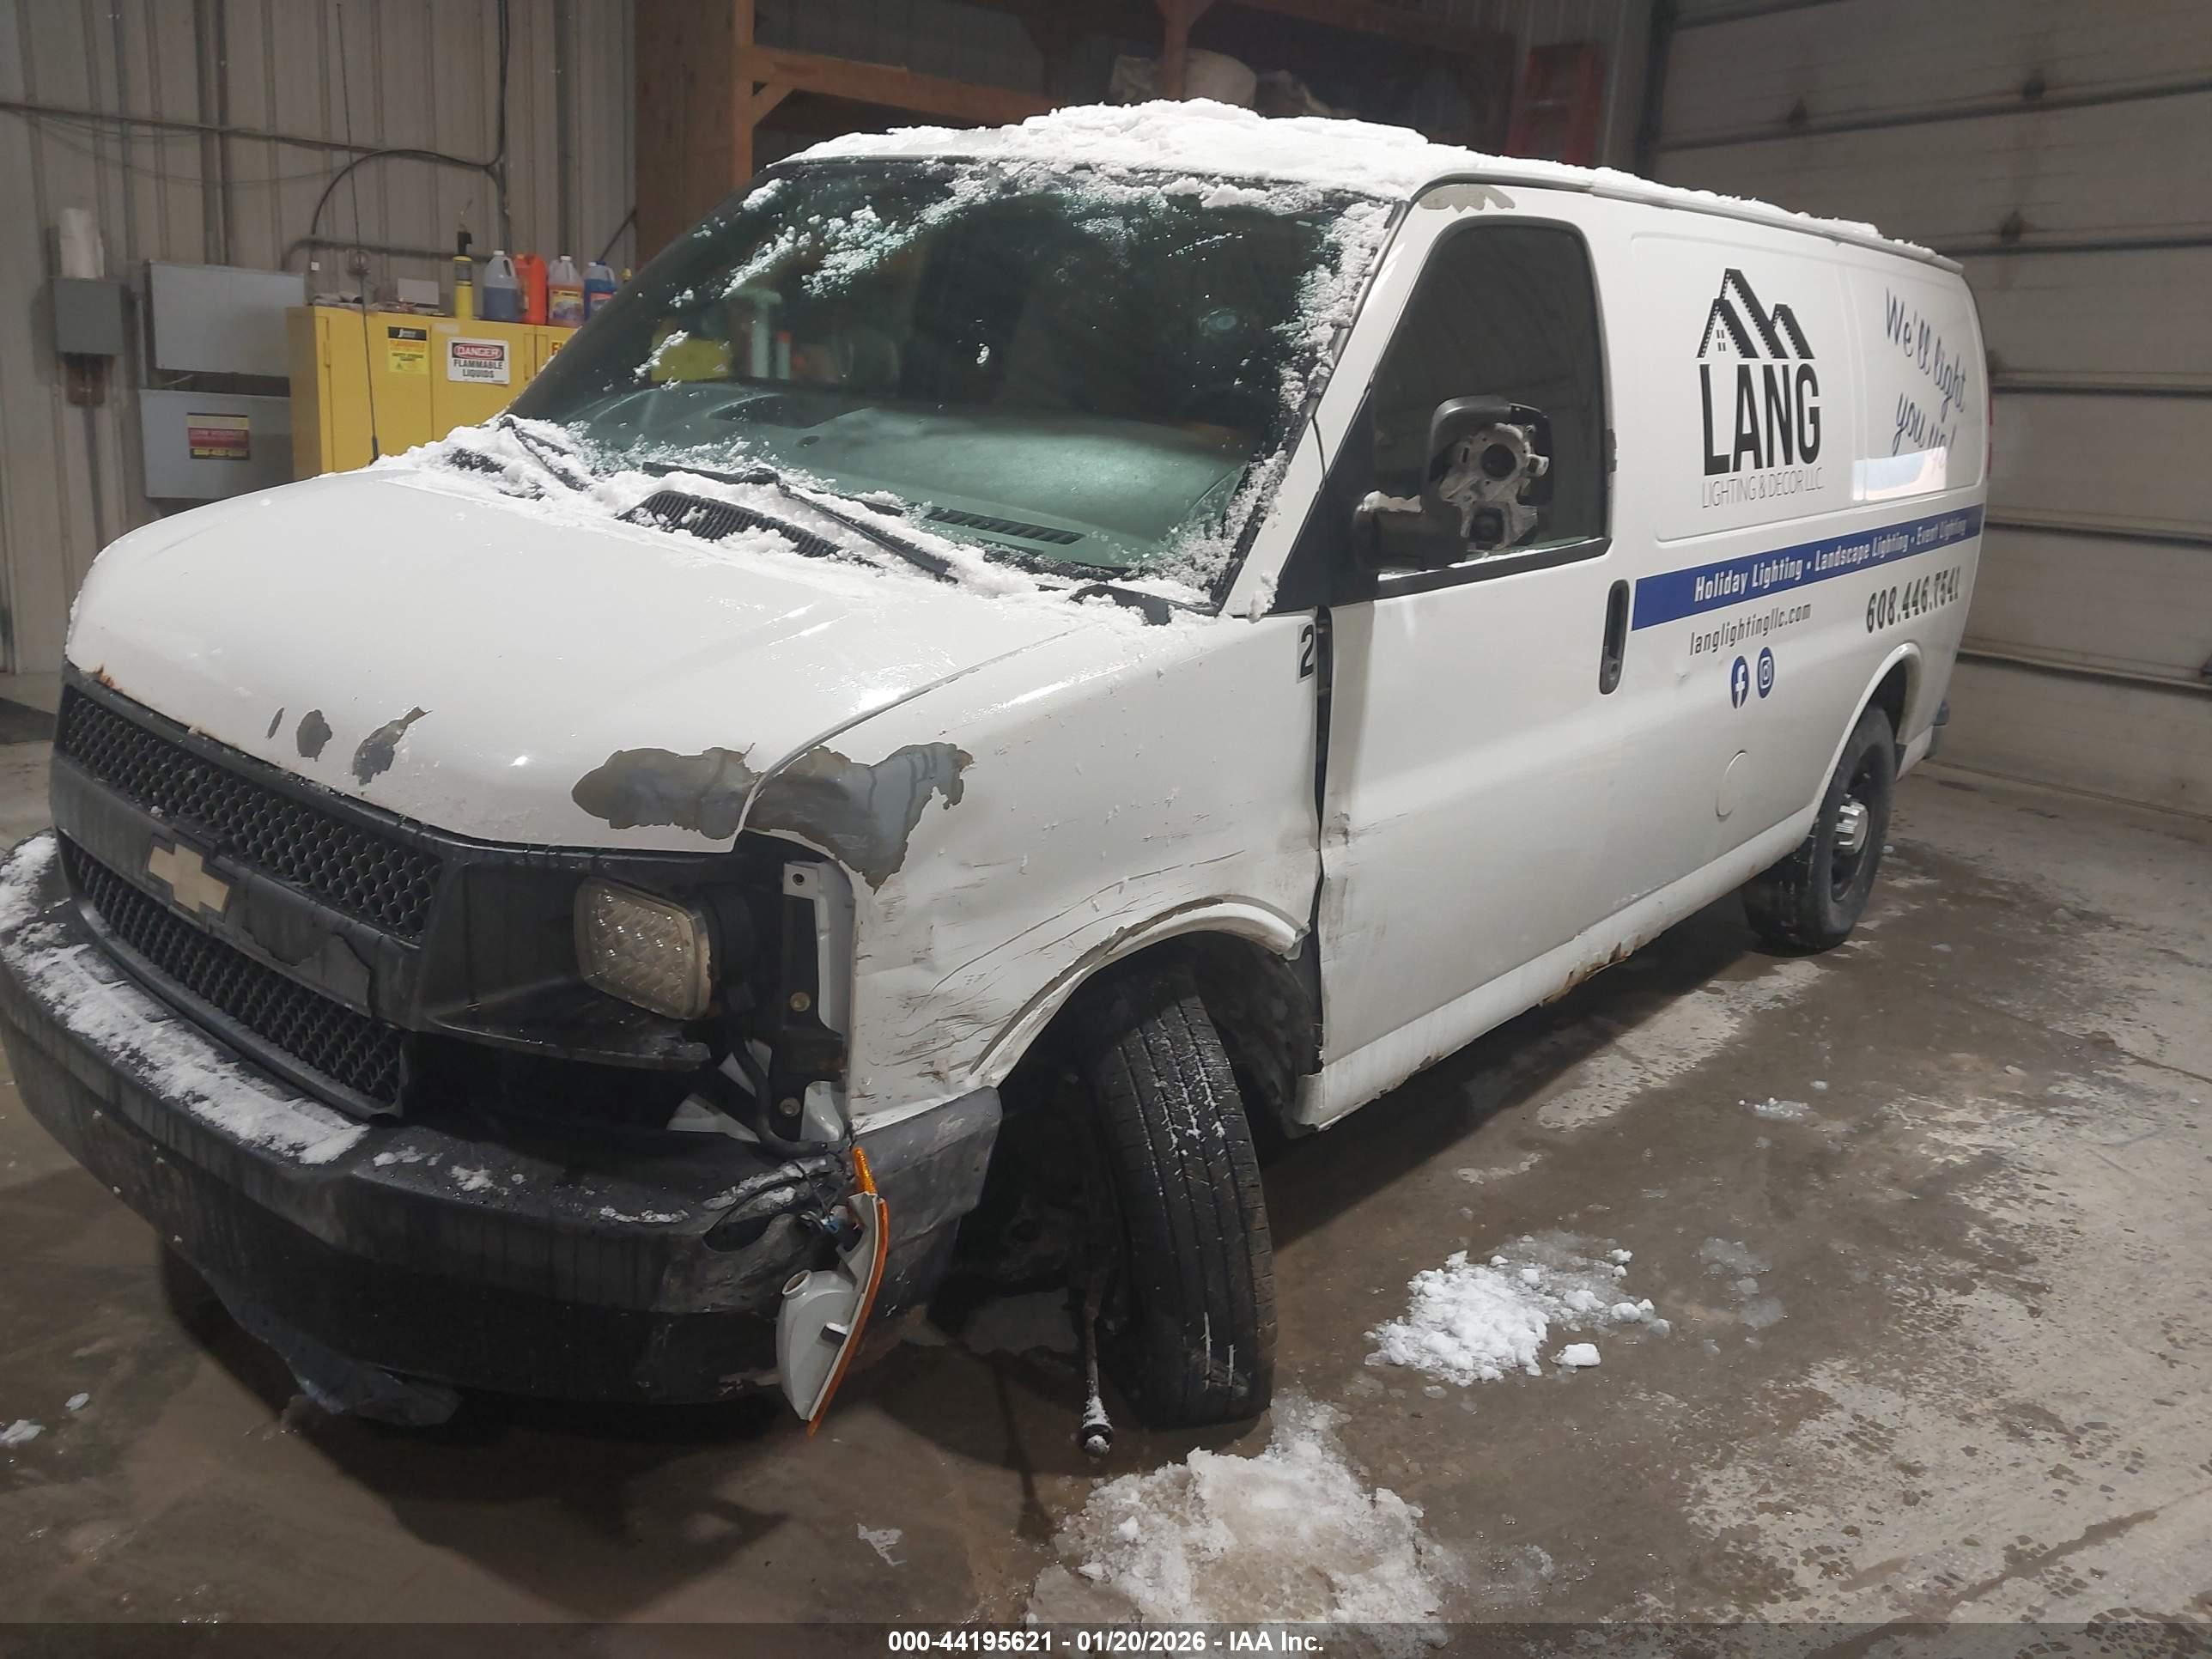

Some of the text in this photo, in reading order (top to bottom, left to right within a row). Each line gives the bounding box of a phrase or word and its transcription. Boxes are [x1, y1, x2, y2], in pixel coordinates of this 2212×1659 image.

[453, 359, 503, 370] FLAMMABLE
[457, 344, 502, 359] DANGER
[462, 368, 495, 379] LIQUIDS
[1886, 286, 1967, 423] We'll light
[1699, 363, 1821, 476] LANG
[1892, 392, 1926, 458] you
[1702, 476, 1756, 508] LIGHTING
[1767, 470, 1804, 498] DECOR
[1694, 518, 1967, 602] Holiday Lighting Landscape Lighting Event Lighting
[1866, 566, 1960, 633] 608.446.7541
[1299, 624, 1315, 678] 2
[1689, 604, 1812, 656] langlightingllc.com
